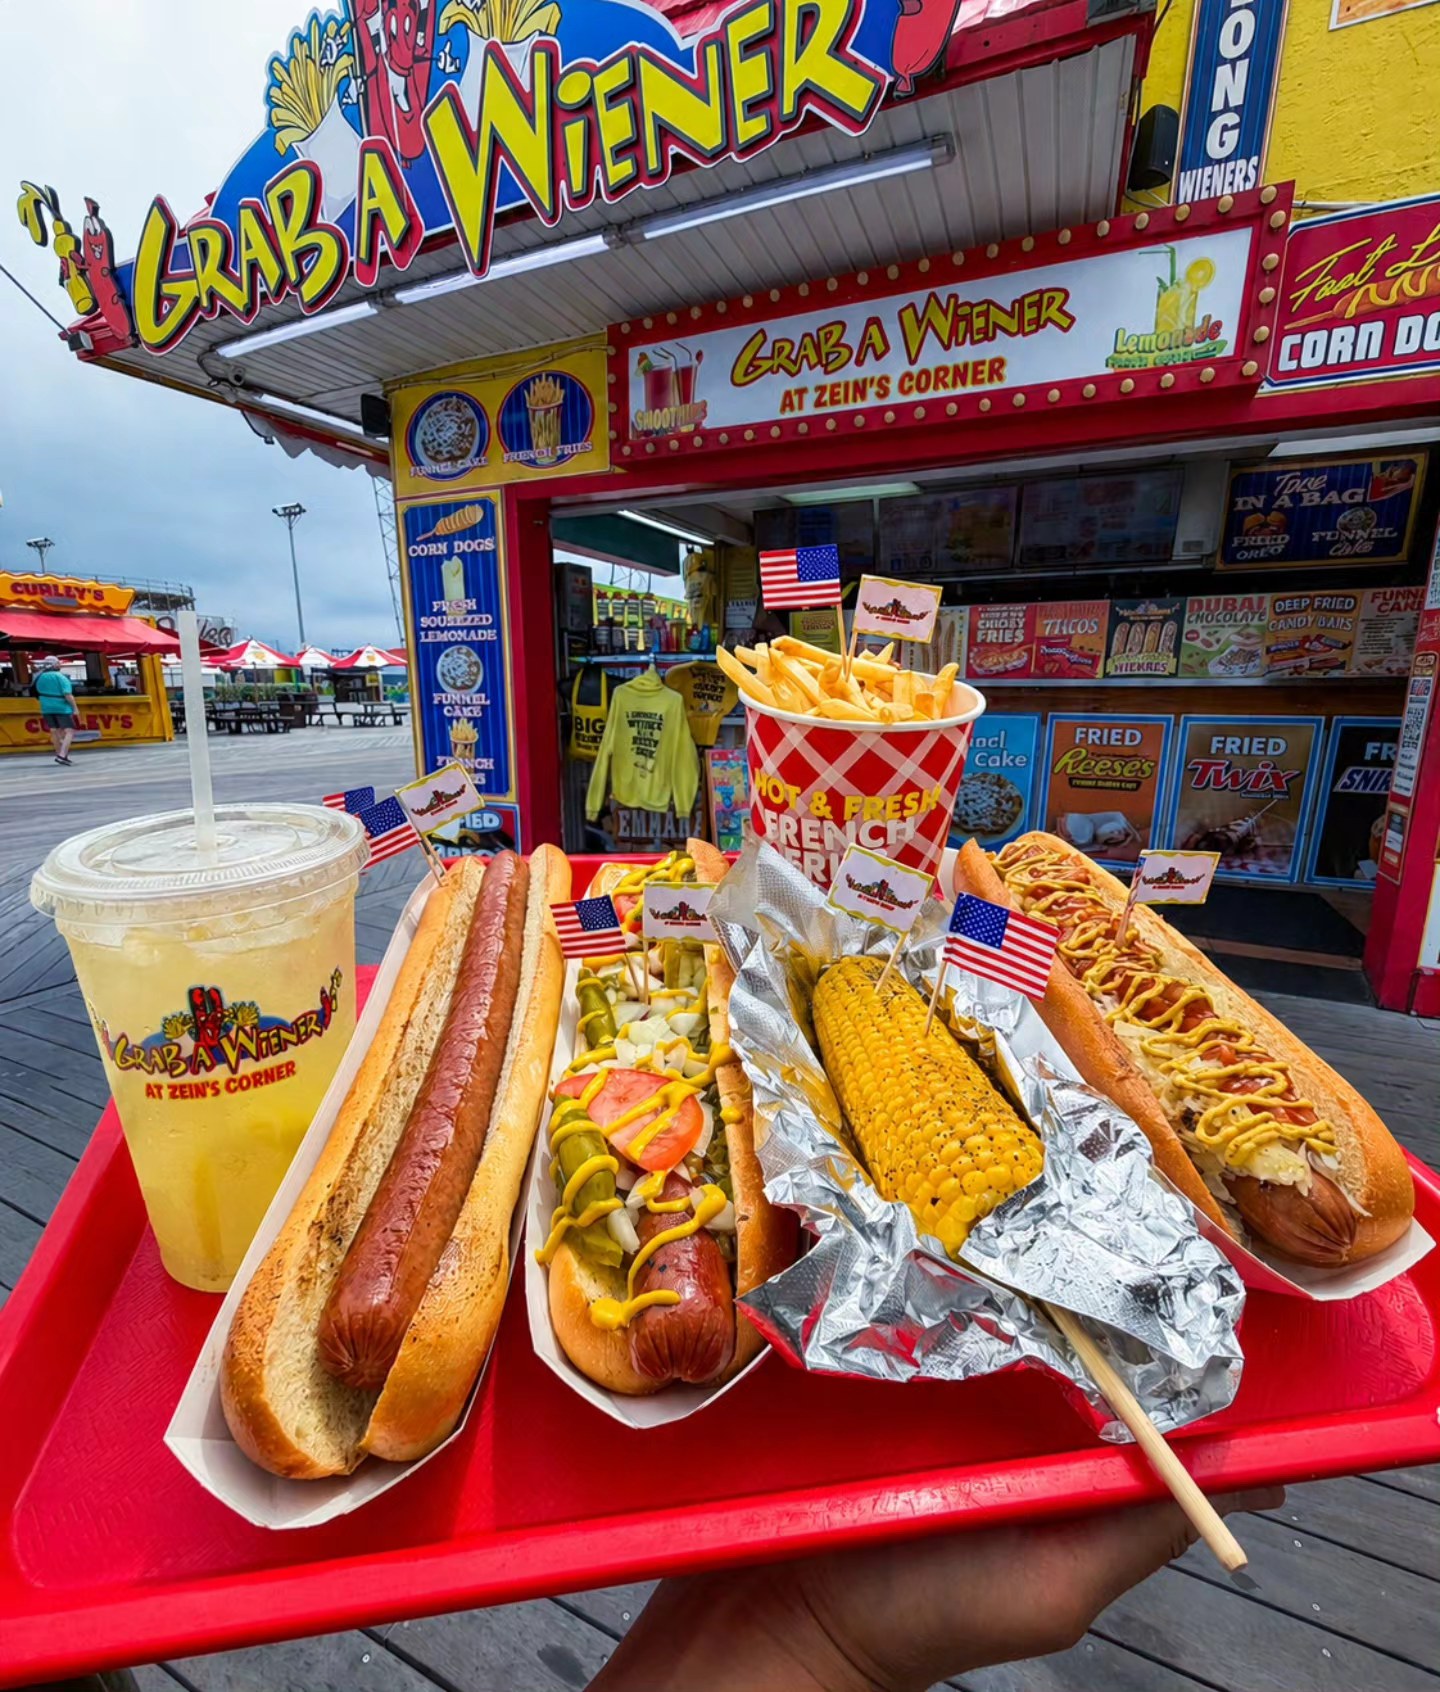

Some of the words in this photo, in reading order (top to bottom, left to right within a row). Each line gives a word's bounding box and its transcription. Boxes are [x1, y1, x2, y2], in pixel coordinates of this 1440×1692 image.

[1205, 0, 1256, 160] ONG
[1178, 156, 1259, 204] WIENERS
[132, 163, 344, 349] GRAB
[358, 148, 411, 265] A
[1114, 314, 1223, 353] Lemonade
[731, 321, 853, 387] GRAB
[854, 316, 891, 367] A
[1278, 320, 1384, 372] CORN
[780, 387, 808, 415] AT
[814, 375, 892, 410] ZEIN'S
[898, 356, 1008, 397] CORNER
[503, 449, 551, 463] FRENCH
[557, 441, 593, 455] FRIES
[410, 460, 452, 477] FUNNEL
[456, 456, 489, 472] CAKE
[1233, 495, 1267, 511] IN
[1272, 495, 1294, 509] A
[1299, 488, 1367, 507] BAG
[1231, 534, 1290, 548] FRIED
[1312, 527, 1398, 543] FUNNEL
[408, 542, 449, 557] CORN
[454, 538, 494, 553] DOGS
[1236, 545, 1286, 560] OREO
[10, 582, 105, 602] CURLEY'S
[432, 599, 477, 613] FRESH
[1188, 596, 1266, 613] DUBAI
[1275, 598, 1310, 612] DEEP
[1313, 596, 1355, 610] FRIED
[1187, 610, 1266, 625] CHOCOLATE
[1268, 616, 1314, 631] CANDY
[420, 629, 497, 643] LEMONADE
[976, 629, 1025, 645] FRIES
[433, 693, 490, 706] FUNNEL
[443, 706, 483, 718] CAKE
[25, 714, 133, 734] CULEY'S
[575, 715, 606, 734] BIG
[1075, 727, 1143, 746] FRIED
[1210, 736, 1288, 756] FRIED
[975, 750, 1028, 767] Cake
[754, 768, 800, 810] HOT
[808, 791, 834, 820] &
[843, 783, 942, 821] FRESH
[764, 809, 916, 850] FRENCH
[114, 1032, 188, 1078] GRAB
[189, 1041, 216, 1075] A
[145, 1082, 163, 1100] AT
[168, 1080, 221, 1100] ZEIN'S
[224, 1060, 297, 1095] CORNER
